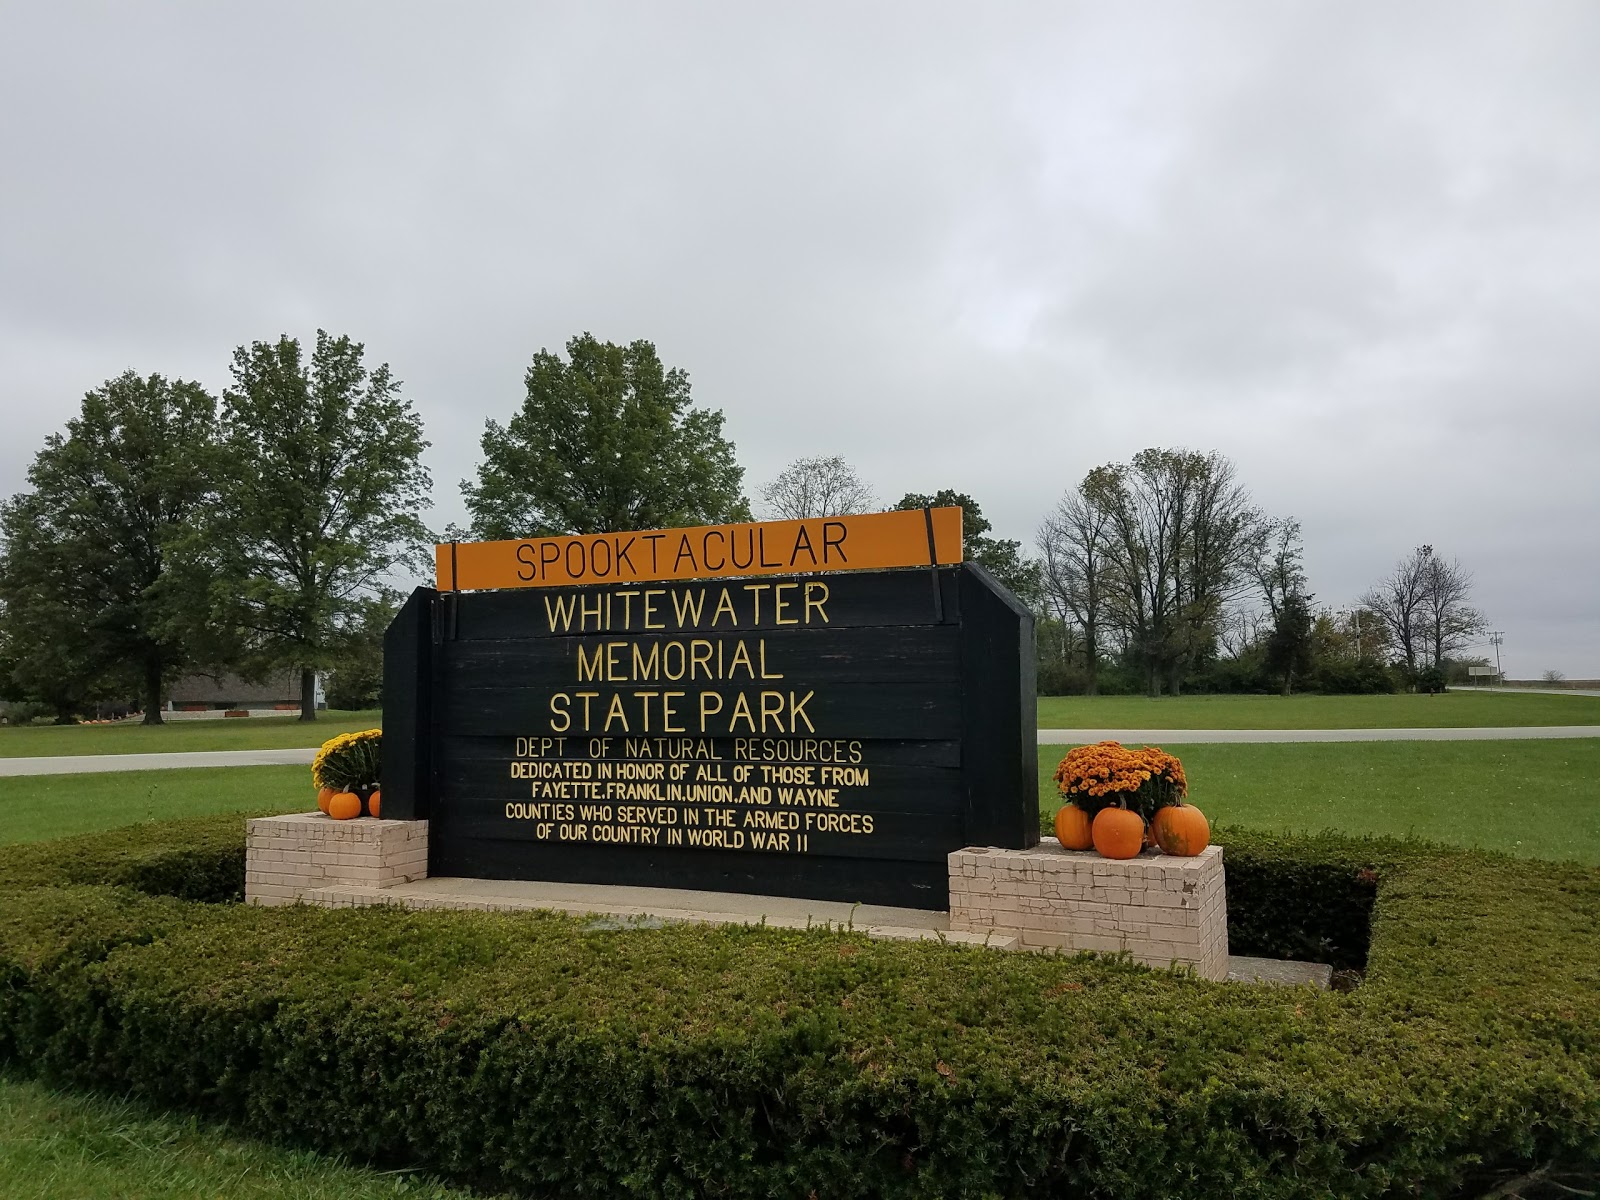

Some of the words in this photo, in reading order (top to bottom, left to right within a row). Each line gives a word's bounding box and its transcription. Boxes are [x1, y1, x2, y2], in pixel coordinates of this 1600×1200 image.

[516, 521, 848, 582] SPOOKTACULAR
[544, 581, 830, 632] WHITEWATER
[577, 639, 784, 682] MEMORIAL
[550, 692, 686, 732] STATE
[700, 690, 815, 734] PARK
[516, 737, 567, 756] DEPT
[589, 738, 613, 758] OF
[625, 738, 722, 760] NATURAL
[735, 739, 862, 763] RESOURCES
[511, 763, 592, 779] DEDICATED
[597, 764, 612, 780] IN
[616, 764, 664, 780] HONOR
[669, 765, 689, 780] OF
[696, 765, 727, 782] ALL
[733, 766, 753, 782] OF
[761, 767, 815, 784] THOSE
[821, 768, 869, 786] FROM
[738, 786, 772, 805] AND
[778, 788, 840, 807] WAYNE
[505, 803, 574, 821] COUNTIES
[579, 805, 613, 821] WHO
[617, 807, 677, 824] SERVED
[683, 809, 698, 825] IN
[704, 809, 736, 827] THE
[744, 810, 799, 830] ARMED
[805, 813, 873, 834] FORCES
[536, 823, 555, 839] OF
[560, 824, 588, 840] OUR
[593, 825, 660, 844] COUNTRY
[667, 828, 682, 844] IN
[688, 830, 744, 848] WORLD
[751, 832, 790, 851] WAR
